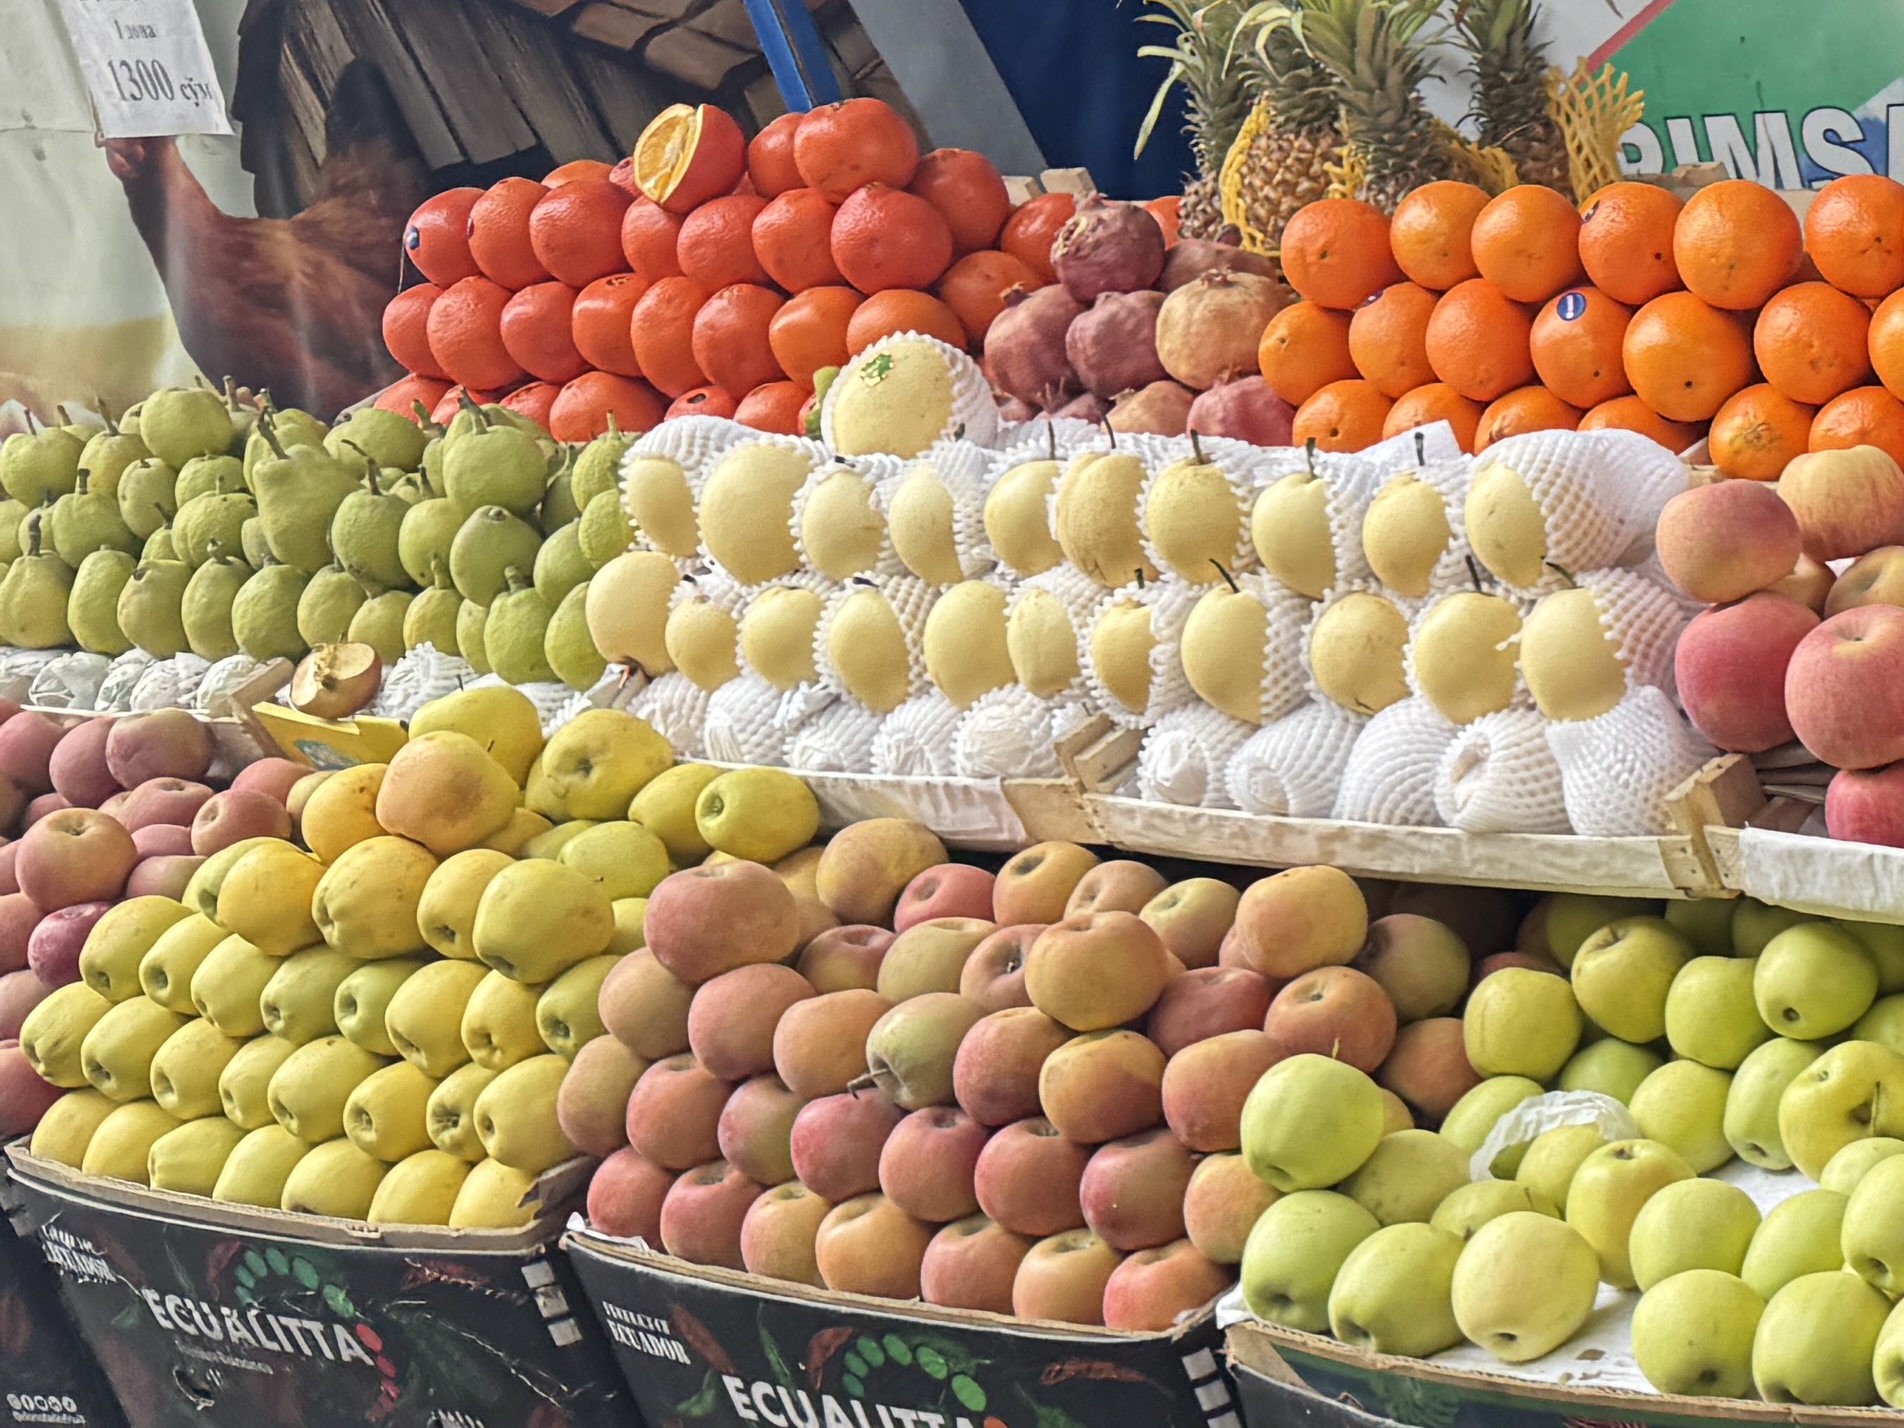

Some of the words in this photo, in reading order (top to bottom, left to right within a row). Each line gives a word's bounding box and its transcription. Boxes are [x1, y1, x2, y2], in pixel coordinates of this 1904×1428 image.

[107, 59, 175, 102] 1300
[141, 1287, 375, 1366] ECUALITTA
[606, 1318, 691, 1365] ECUADOR
